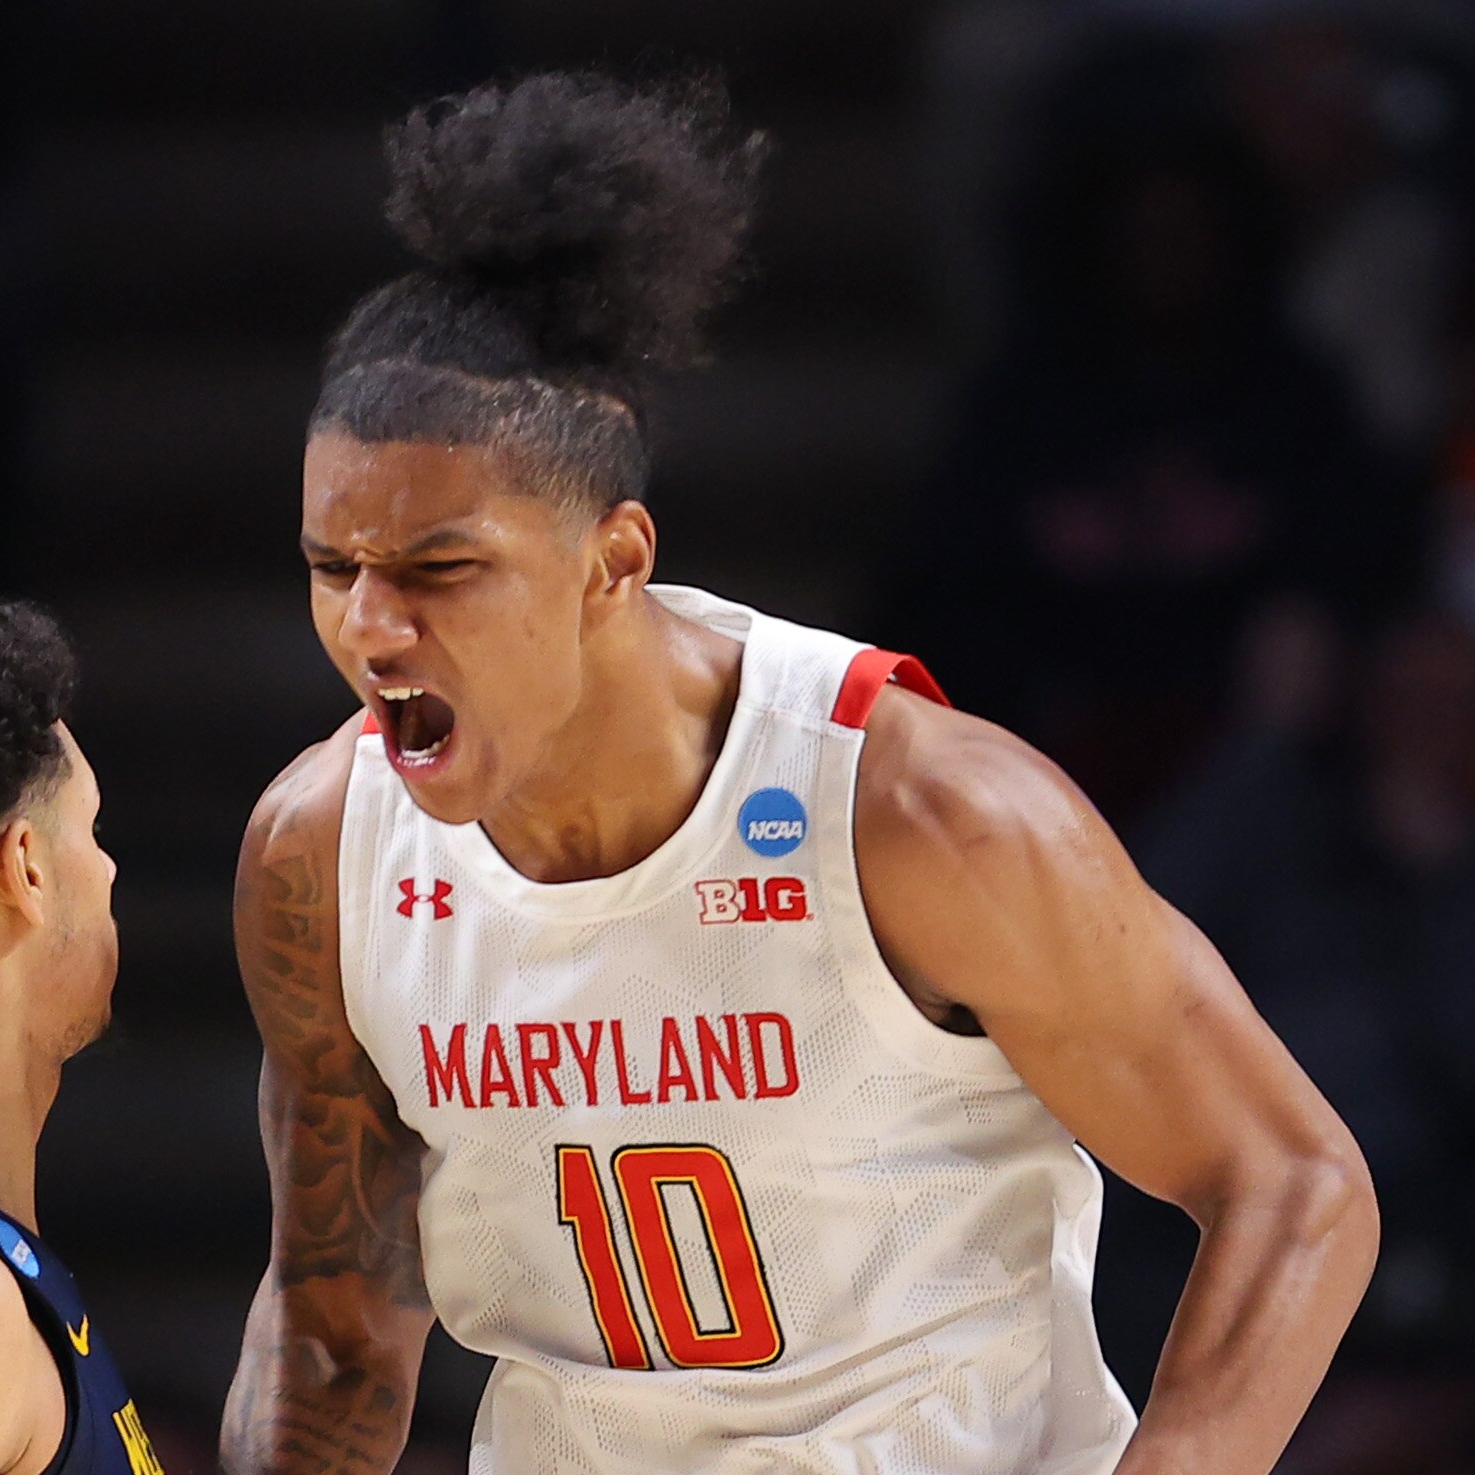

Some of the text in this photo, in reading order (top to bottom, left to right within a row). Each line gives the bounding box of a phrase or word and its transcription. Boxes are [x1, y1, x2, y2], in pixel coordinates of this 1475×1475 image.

[748, 820, 803, 841] NCAA
[418, 1012, 801, 1110] MARYLAND
[554, 1144, 786, 1371] 10
